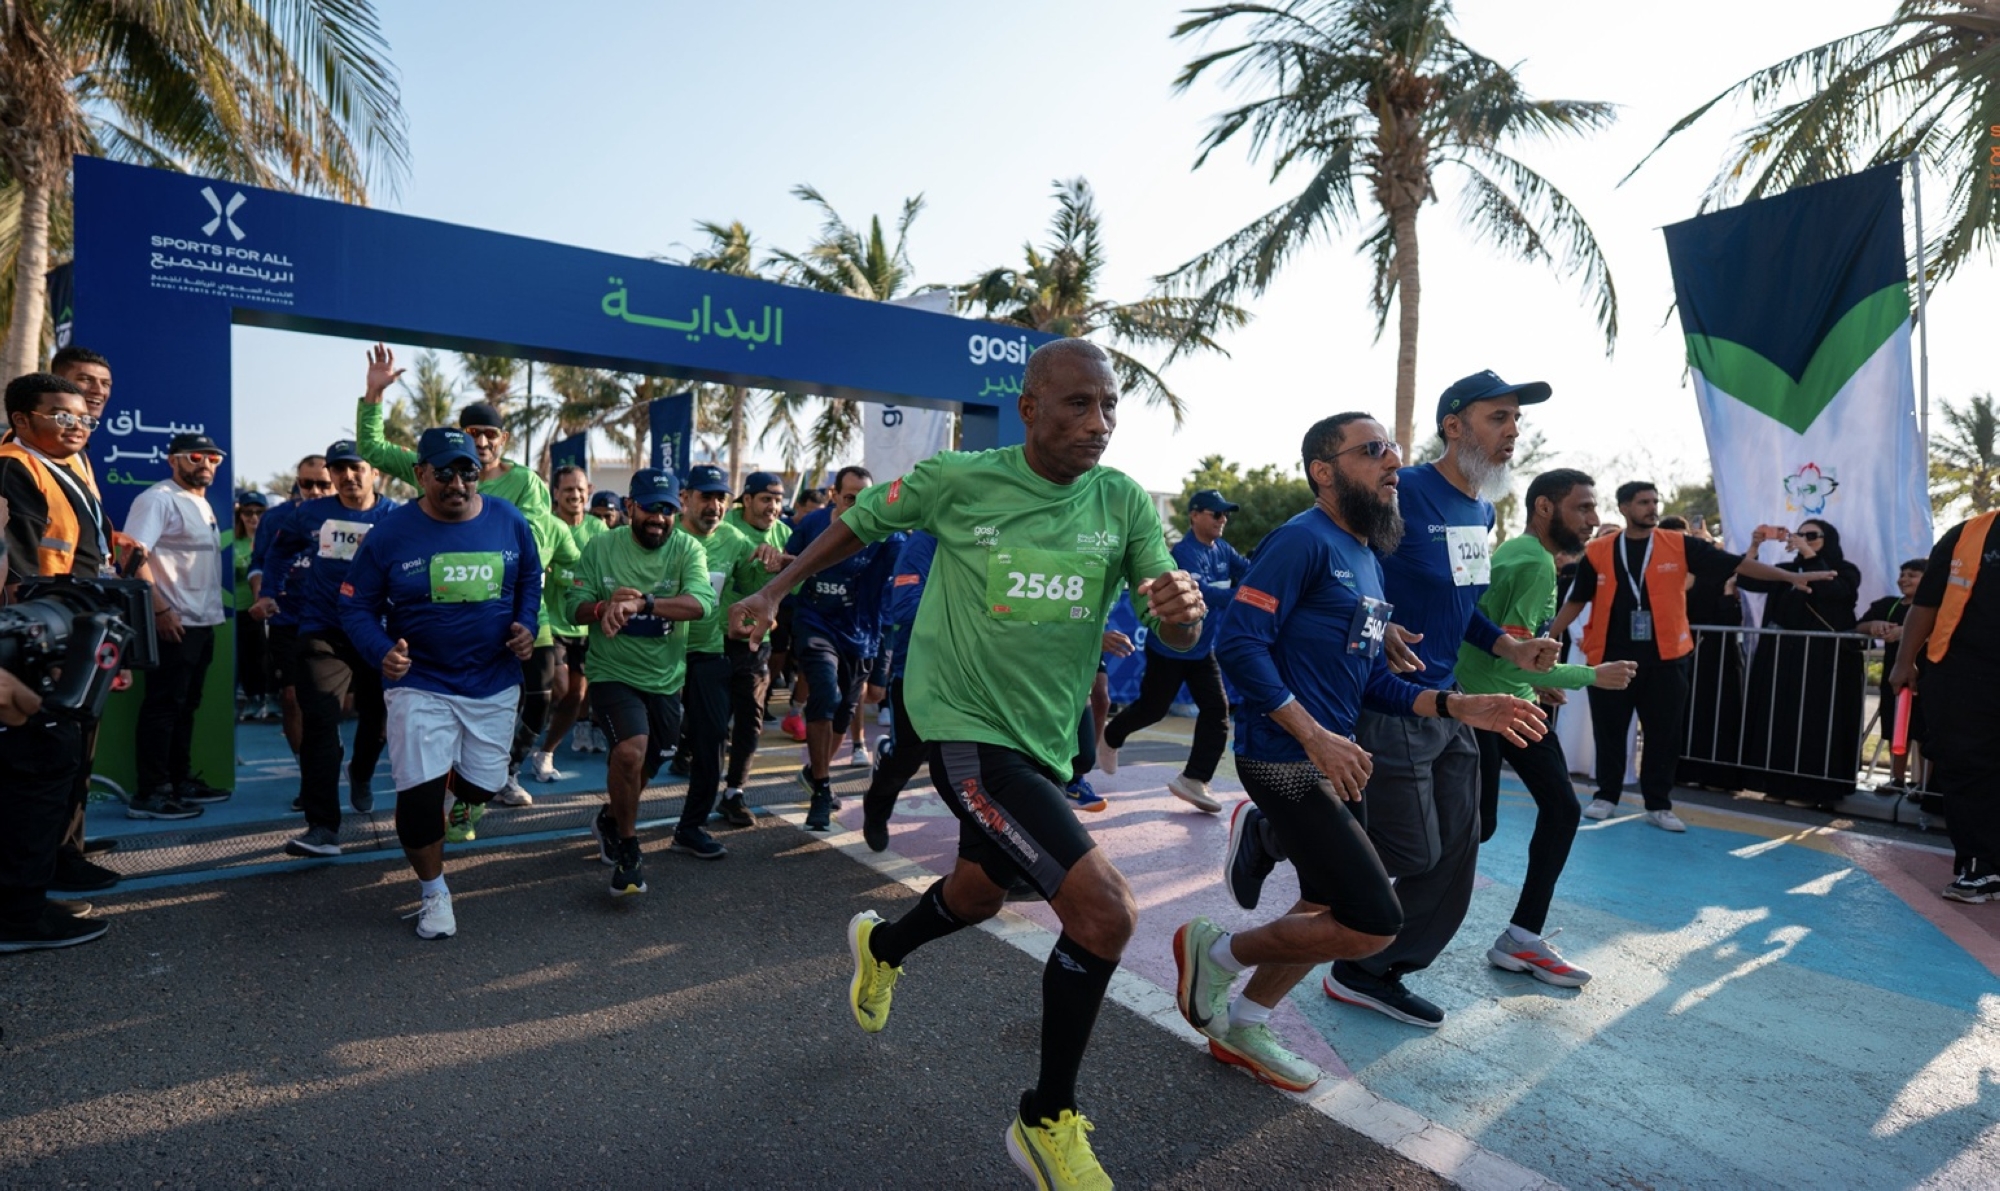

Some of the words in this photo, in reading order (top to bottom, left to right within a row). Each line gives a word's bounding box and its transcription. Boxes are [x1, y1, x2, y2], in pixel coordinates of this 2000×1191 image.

[151, 235, 222, 256] SPORTS
[225, 247, 260, 261] FOR
[262, 253, 293, 267] ALL
[151, 252, 222, 272] للجميع
[226, 262, 294, 283] الرياضة
[601, 276, 783, 350] البداية
[968, 334, 1027, 366] gosi
[106, 409, 205, 439] سباق
[331, 530, 357, 545] 116
[974, 525, 995, 537] gosi
[443, 565, 493, 583] 2370
[815, 581, 847, 596] 5356
[1006, 571, 1085, 601] 2568
